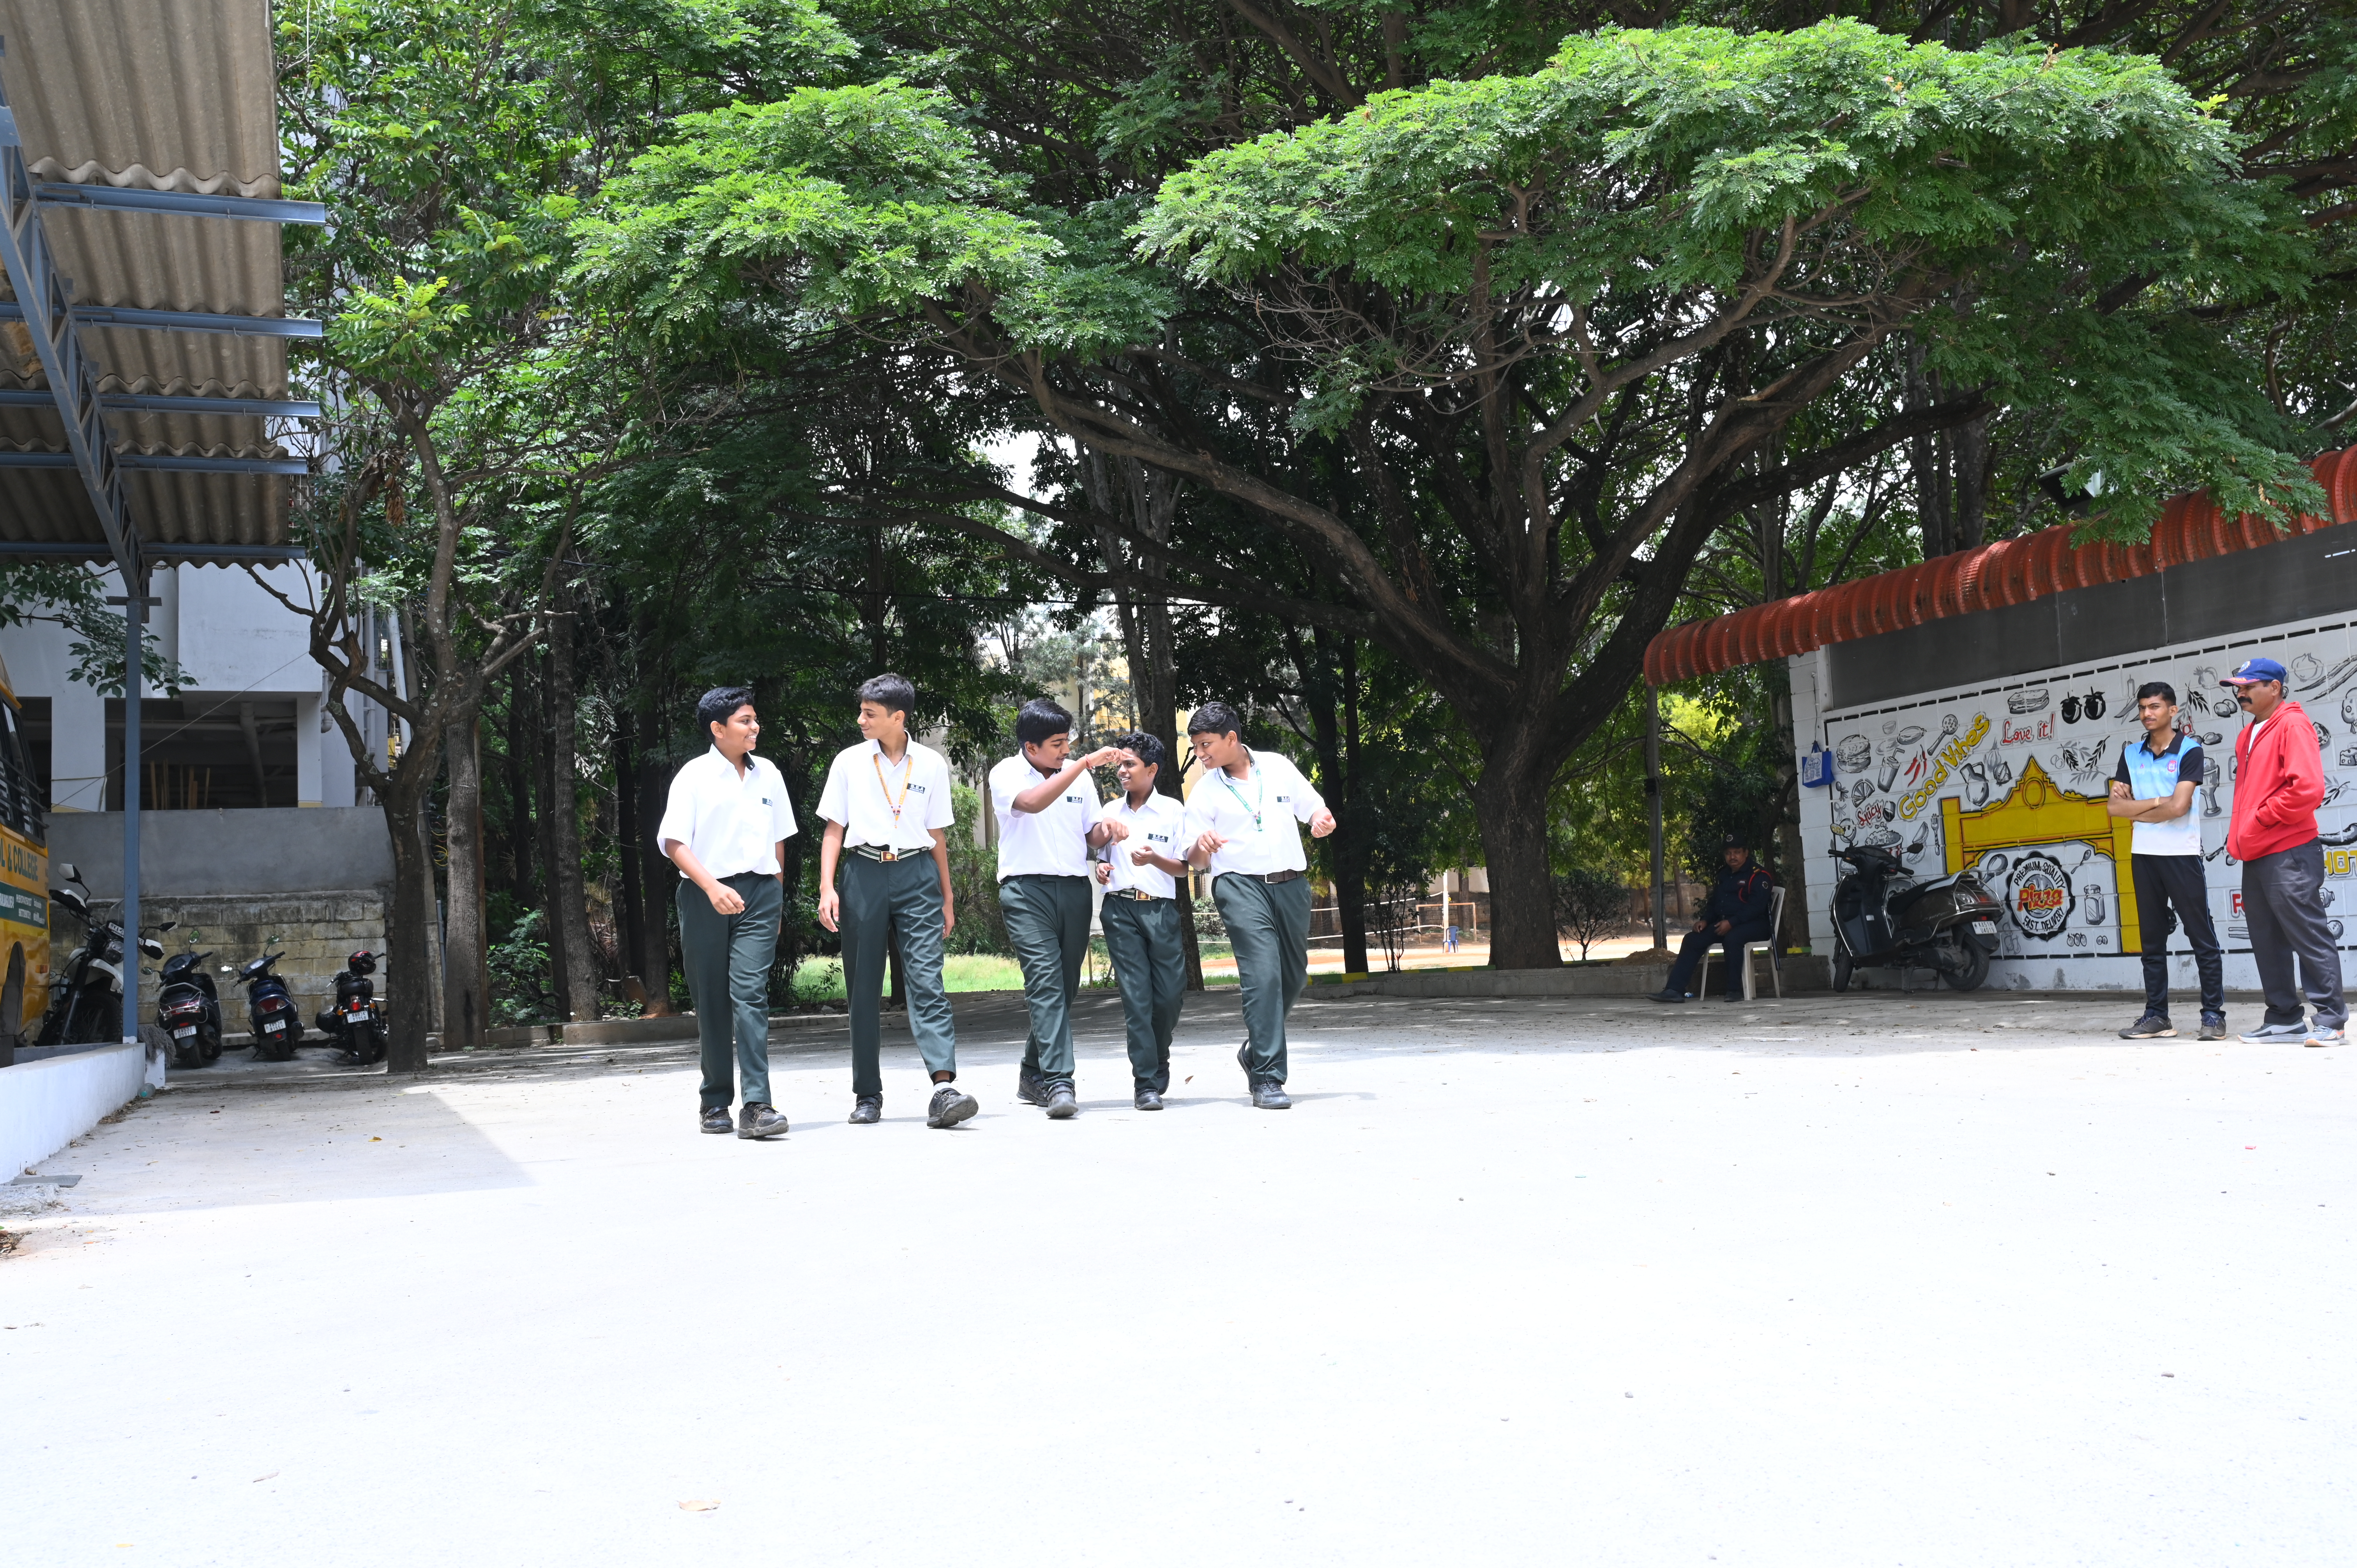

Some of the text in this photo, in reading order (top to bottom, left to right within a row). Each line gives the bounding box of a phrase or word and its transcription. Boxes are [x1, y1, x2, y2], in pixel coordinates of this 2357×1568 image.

[2002, 713, 2054, 743] Love it!
[1857, 803, 1882, 826] Spicy
[8, 844, 12, 872] &
[13, 845, 38, 882] COLLEGE
[2014, 861, 2042, 886] PREMIUM
[2042, 862, 2065, 888] QUALITY
[2017, 883, 2064, 911] Pizza
[2023, 906, 2064, 932] FAST DELIVERY
